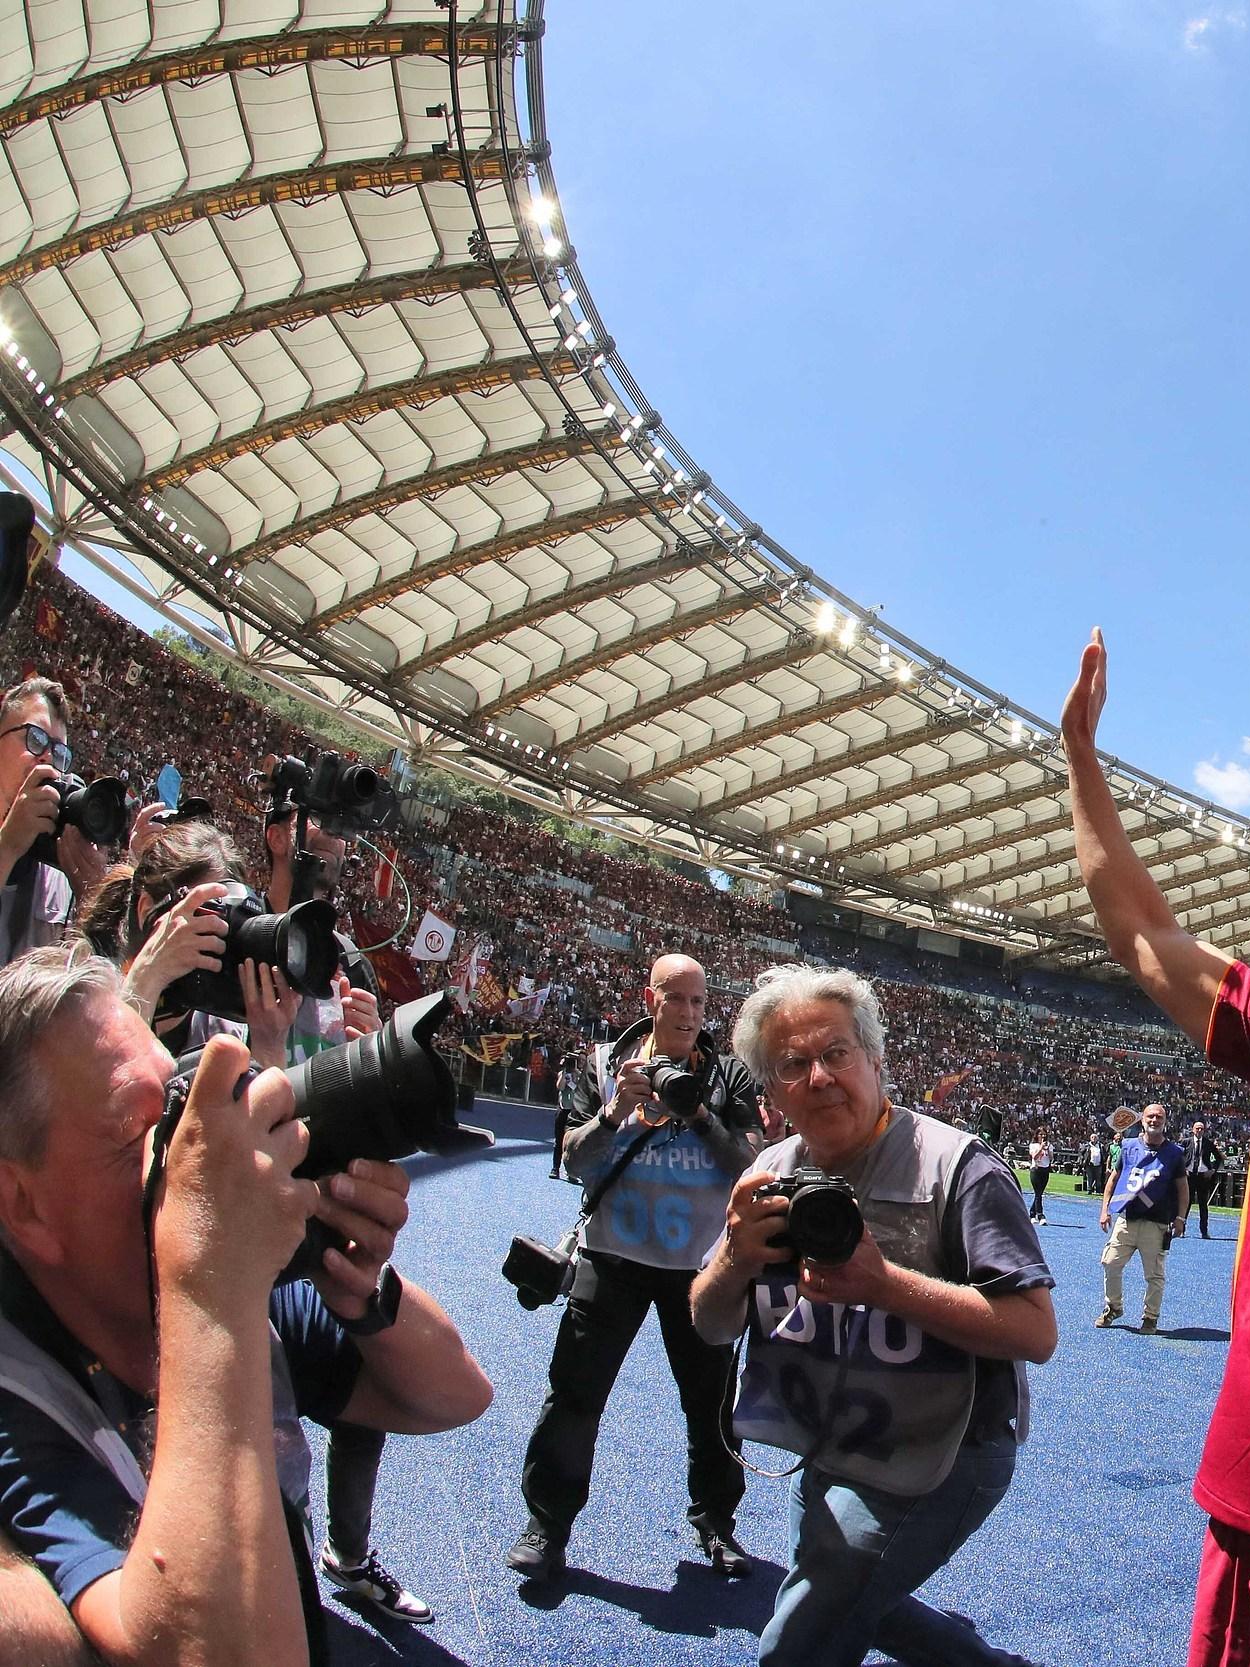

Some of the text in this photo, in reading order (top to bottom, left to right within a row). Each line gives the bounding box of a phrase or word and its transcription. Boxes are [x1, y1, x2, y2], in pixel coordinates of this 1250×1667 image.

[246, 899, 262, 911] Nikon
[668, 1147, 716, 1171] PHO
[611, 1188, 692, 1252] 06
[755, 1284, 924, 1364] HOTO
